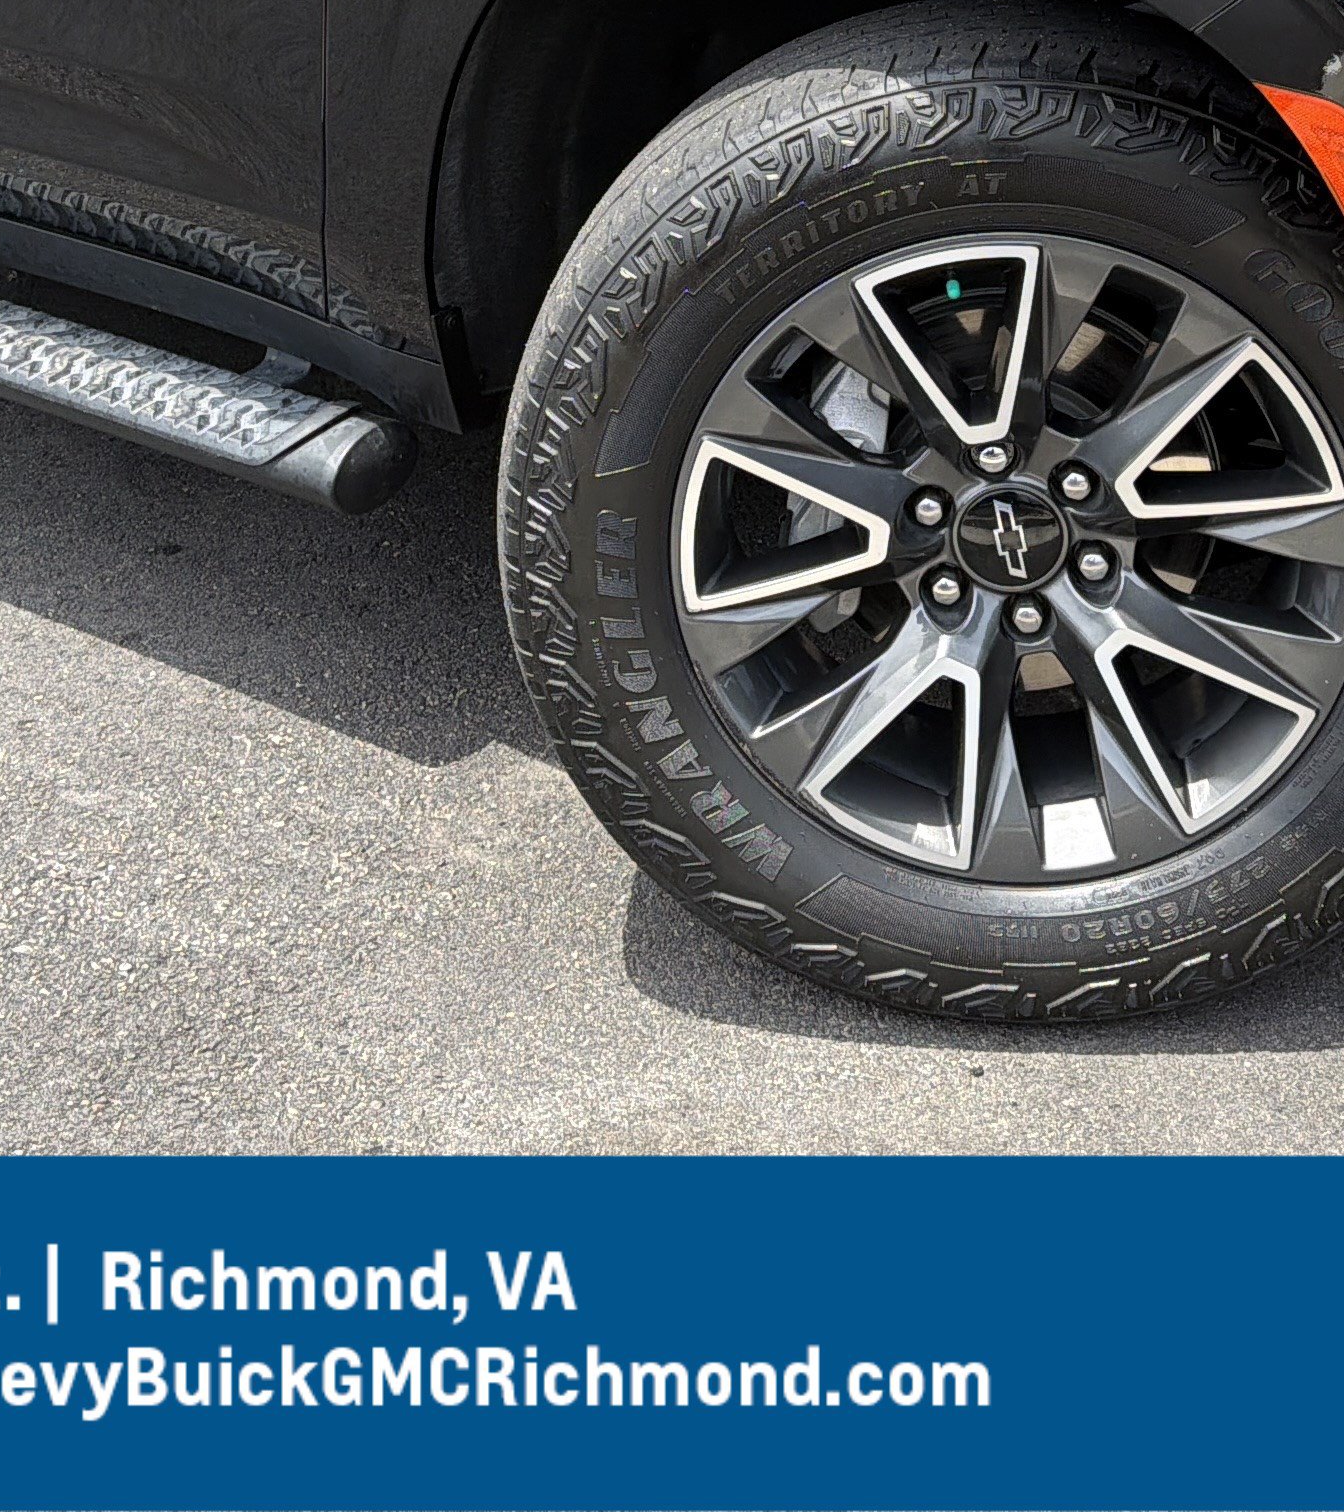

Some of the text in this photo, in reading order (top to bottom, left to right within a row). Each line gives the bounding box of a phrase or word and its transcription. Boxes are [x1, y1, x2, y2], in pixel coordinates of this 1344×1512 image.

[713, 173, 1007, 306] TERRITORY AT
[594, 508, 795, 884] WRANGLER
